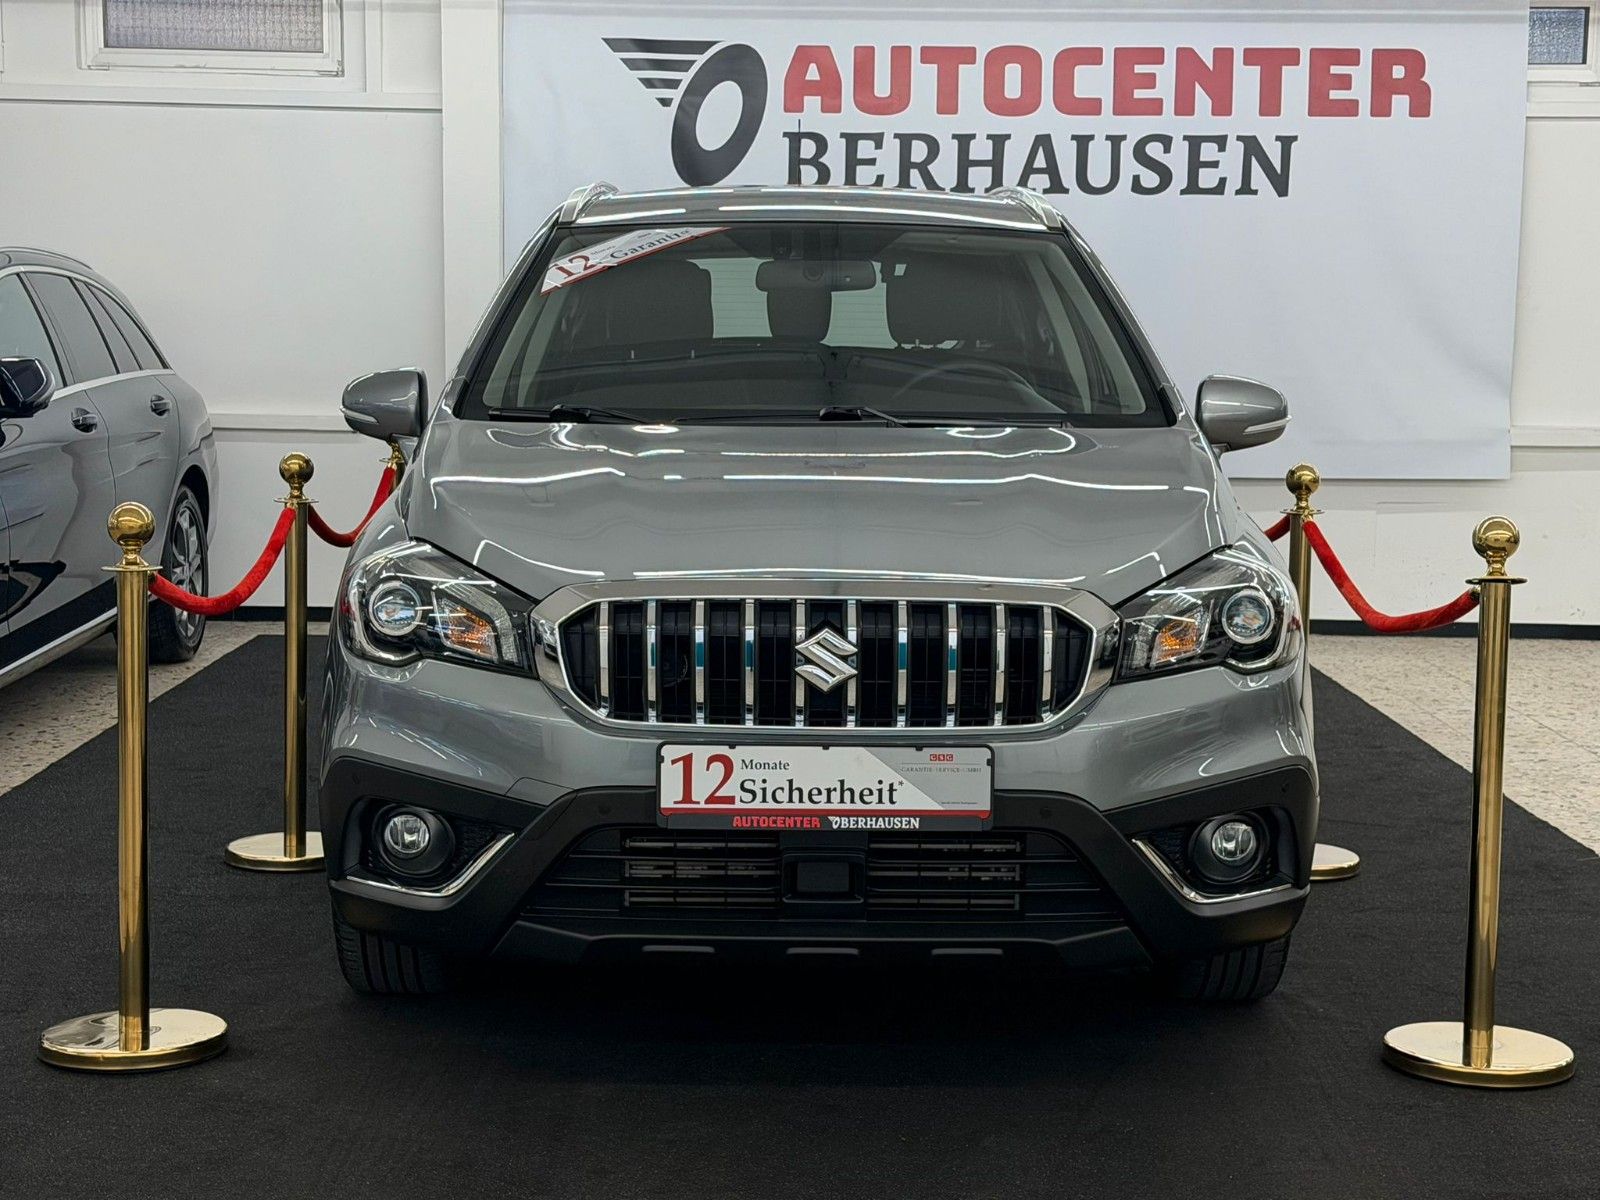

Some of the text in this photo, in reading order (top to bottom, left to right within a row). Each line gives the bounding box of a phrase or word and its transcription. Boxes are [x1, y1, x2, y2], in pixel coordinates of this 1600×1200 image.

[783, 45, 1432, 118] AUTOCENTER
[548, 254, 597, 279] 12
[670, 752, 790, 805] 12 Monate
[732, 816, 821, 828] AUTOCENTER
